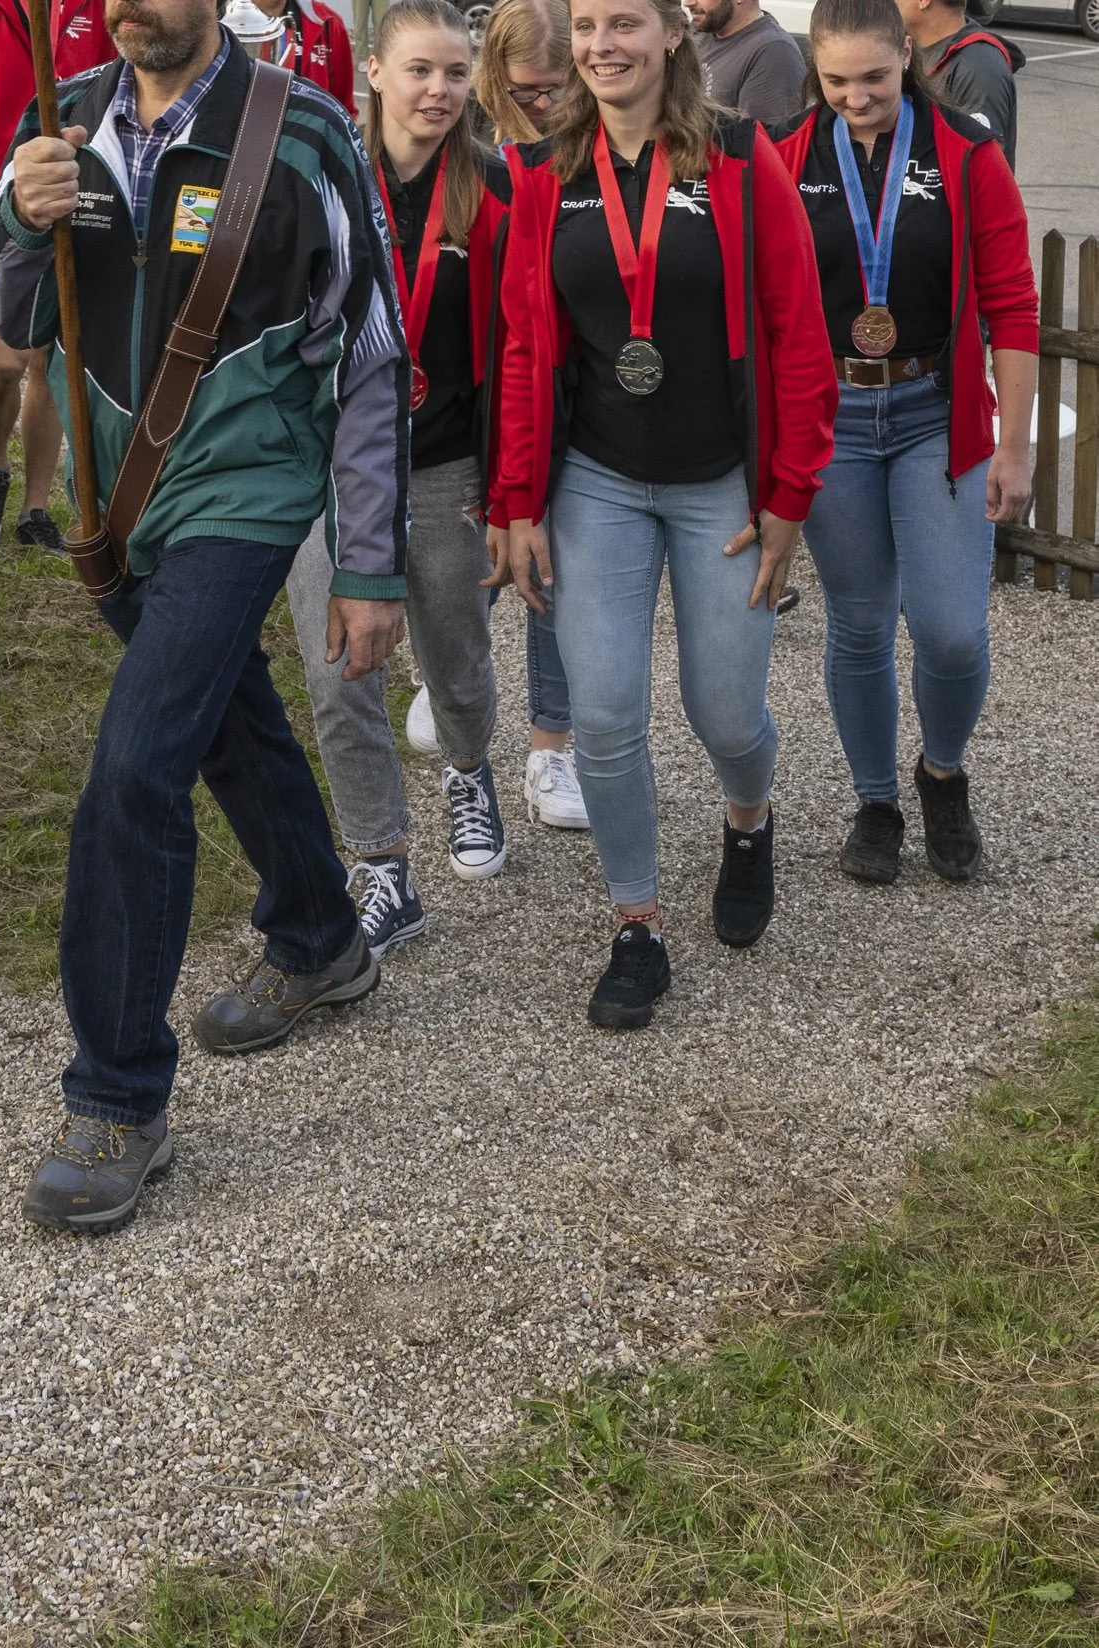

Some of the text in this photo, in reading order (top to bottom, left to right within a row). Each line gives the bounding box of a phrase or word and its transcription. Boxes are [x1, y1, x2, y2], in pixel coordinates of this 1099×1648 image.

[799, 183, 828, 194] CRAFT
[77, 191, 114, 202] restaurant
[77, 200, 94, 209] n-Alp
[561, 199, 597, 209] CRAFT
